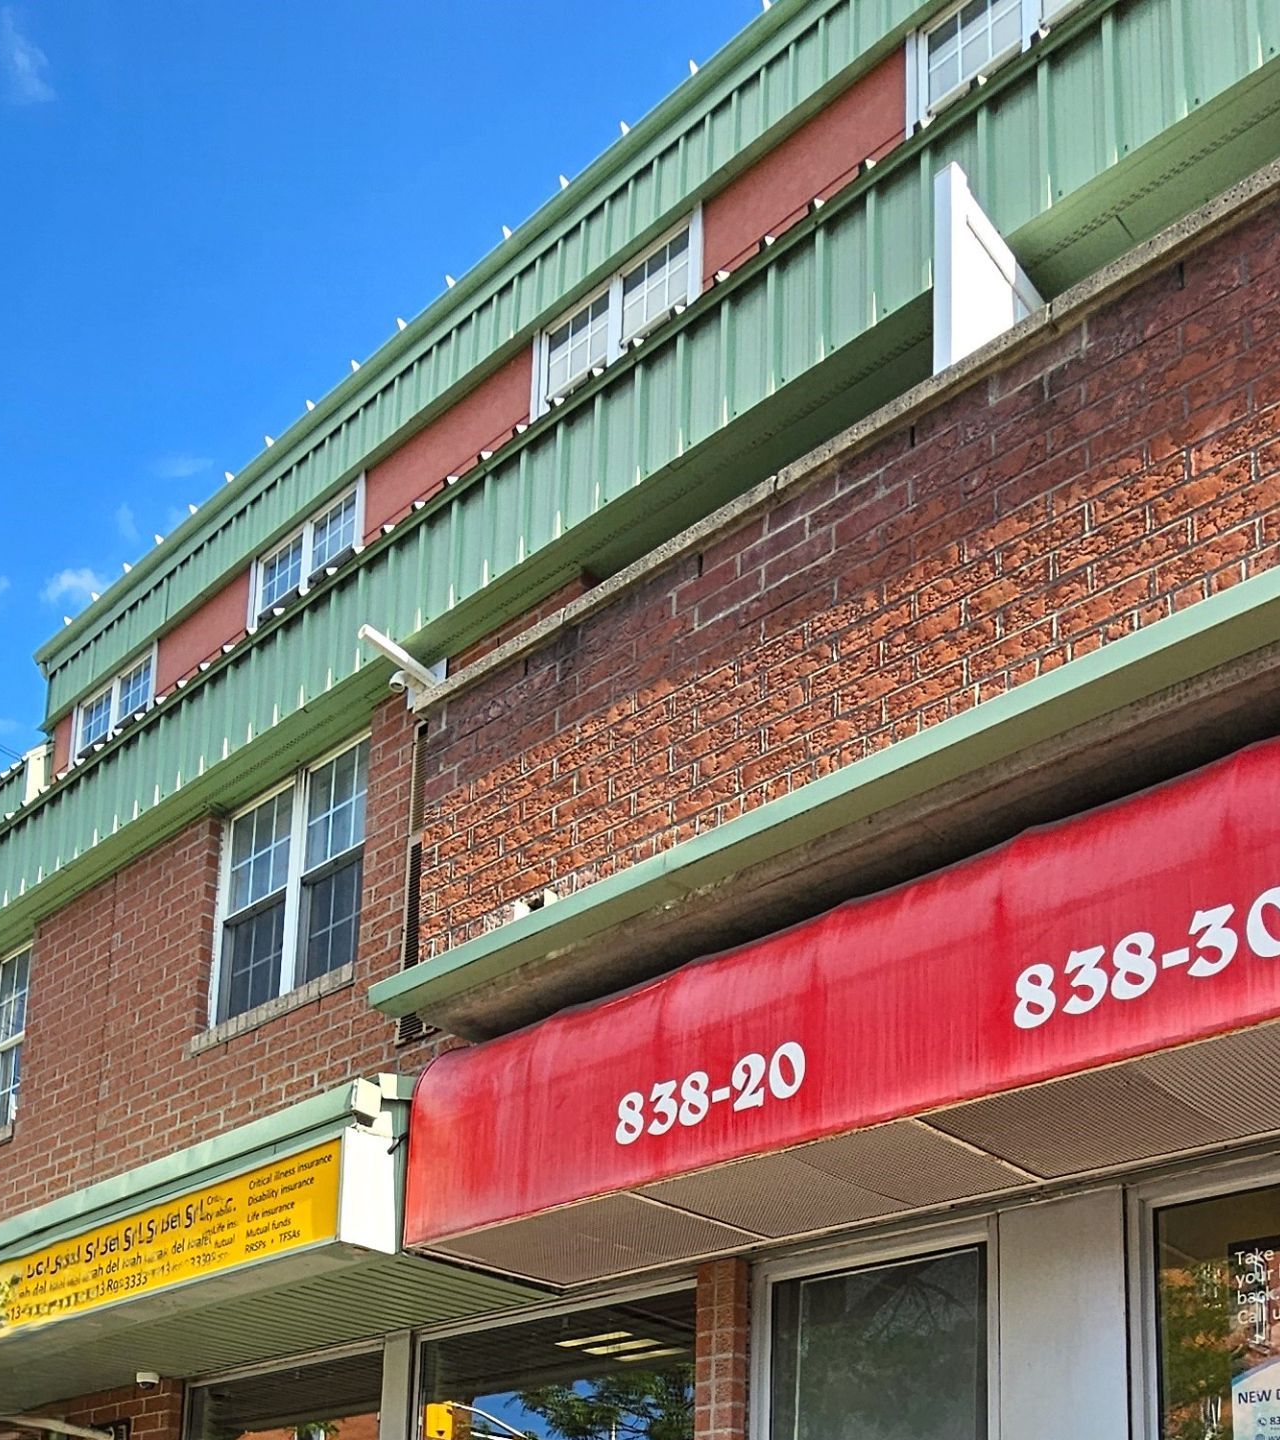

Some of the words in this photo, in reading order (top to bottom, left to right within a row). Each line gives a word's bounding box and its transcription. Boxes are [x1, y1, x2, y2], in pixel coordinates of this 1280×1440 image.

[615, 1042, 806, 1145] 838-20
[249, 1174, 273, 1190] Critical
[297, 1153, 332, 1171] insurance
[248, 1189, 279, 1206] Disability
[281, 1176, 315, 1194] insurance
[246, 1211, 260, 1223] Life
[262, 1201, 295, 1217] insurance
[246, 1223, 270, 1238] Mutual
[271, 1217, 291, 1231] funds
[1234, 1248, 1274, 1265] Take
[1235, 1269, 1274, 1289] your
[1237, 1286, 1280, 1304] back.
[1238, 1390, 1272, 1404] NEW
